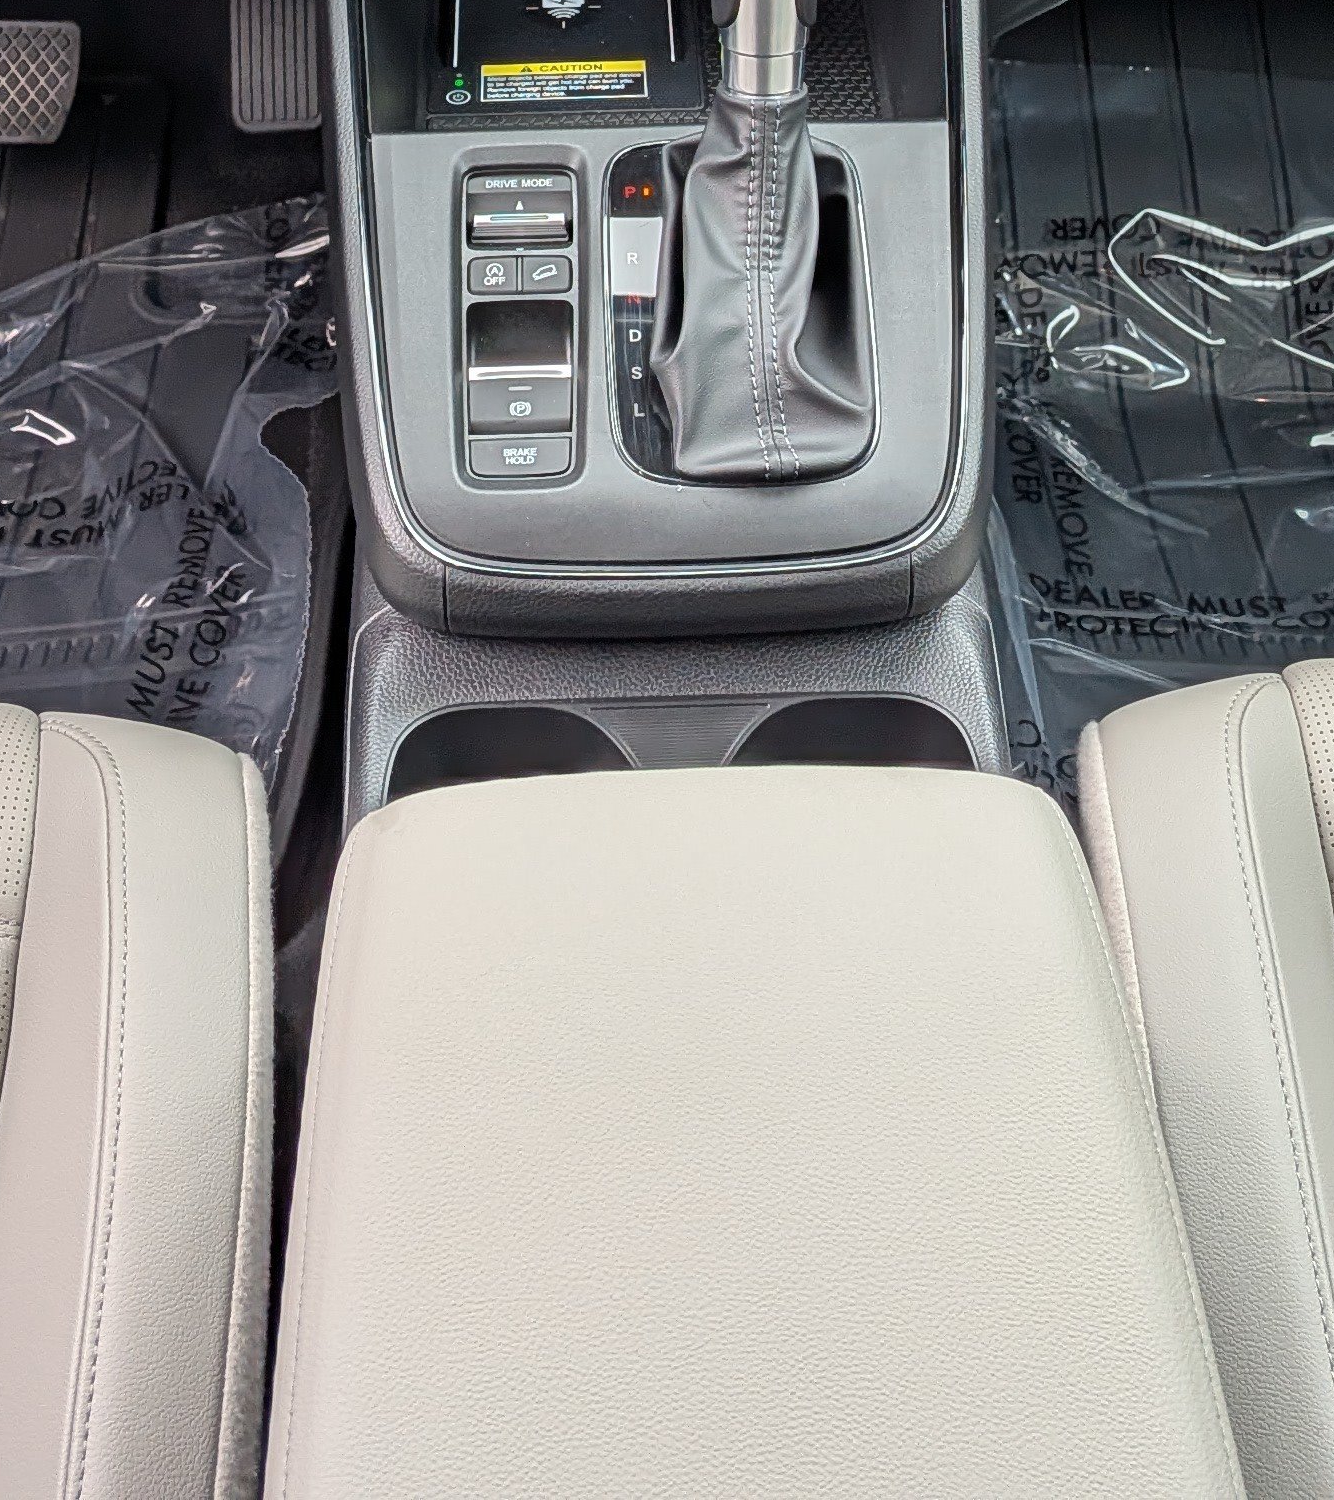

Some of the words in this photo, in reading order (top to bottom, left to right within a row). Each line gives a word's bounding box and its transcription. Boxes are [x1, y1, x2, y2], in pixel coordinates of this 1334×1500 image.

[539, 63, 603, 73] CAUTION
[485, 179, 518, 188] DRIVE
[521, 178, 553, 188] MODE
[623, 186, 636, 198] P
[626, 252, 638, 265] R
[484, 276, 506, 286] OFF
[629, 329, 642, 342] D
[631, 366, 642, 380] S
[633, 403, 645, 417] L
[503, 447, 537, 457] BRAKE
[505, 456, 535, 465] HOLD
[1028, 573, 1156, 610] DEALER
[1185, 592, 1287, 621] MUST
[125, 621, 181, 720] MUST
[161, 506, 217, 610] REMOVE
